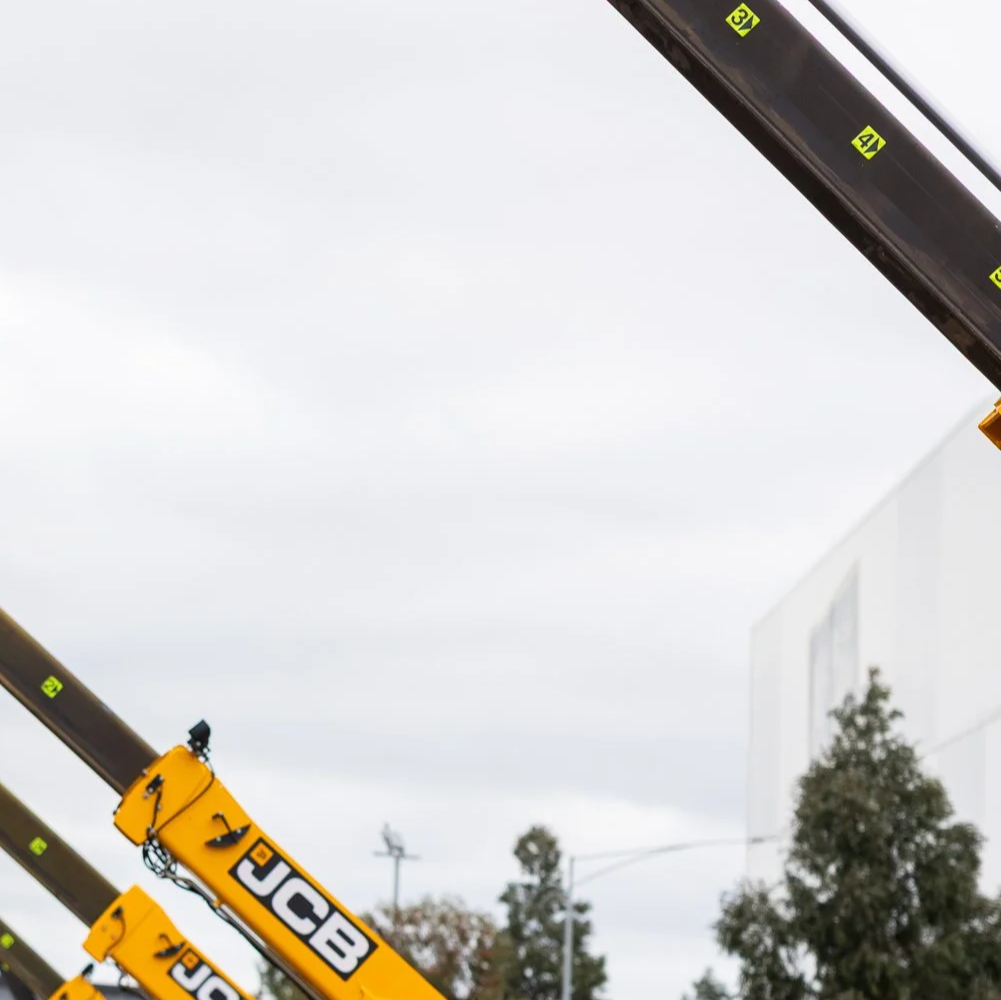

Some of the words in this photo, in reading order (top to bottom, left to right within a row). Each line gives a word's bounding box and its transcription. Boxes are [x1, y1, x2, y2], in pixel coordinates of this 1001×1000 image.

[731, 8, 749, 26] 3
[858, 133, 875, 149] 4
[236, 857, 371, 974] JCB
